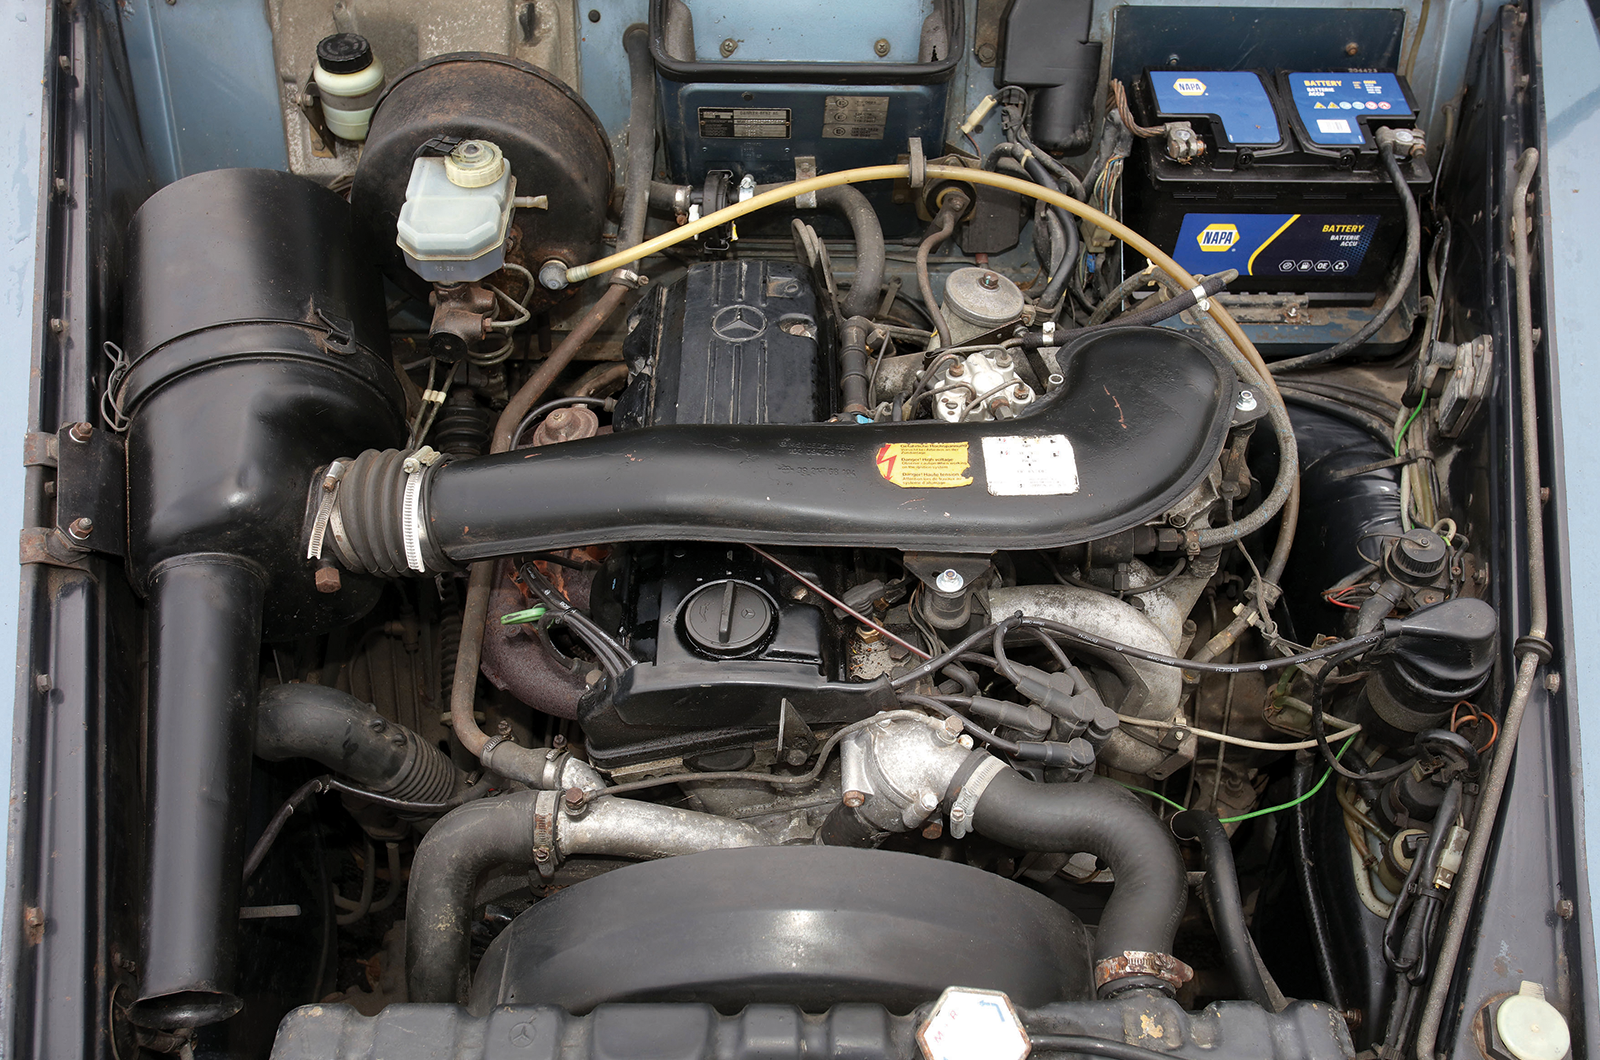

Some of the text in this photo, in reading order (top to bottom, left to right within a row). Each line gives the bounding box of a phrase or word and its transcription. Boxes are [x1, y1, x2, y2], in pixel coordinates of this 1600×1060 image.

[1179, 83, 1202, 91] NAPA
[1322, 225, 1365, 233] BATTERY
[1202, 231, 1234, 245] NAPA
